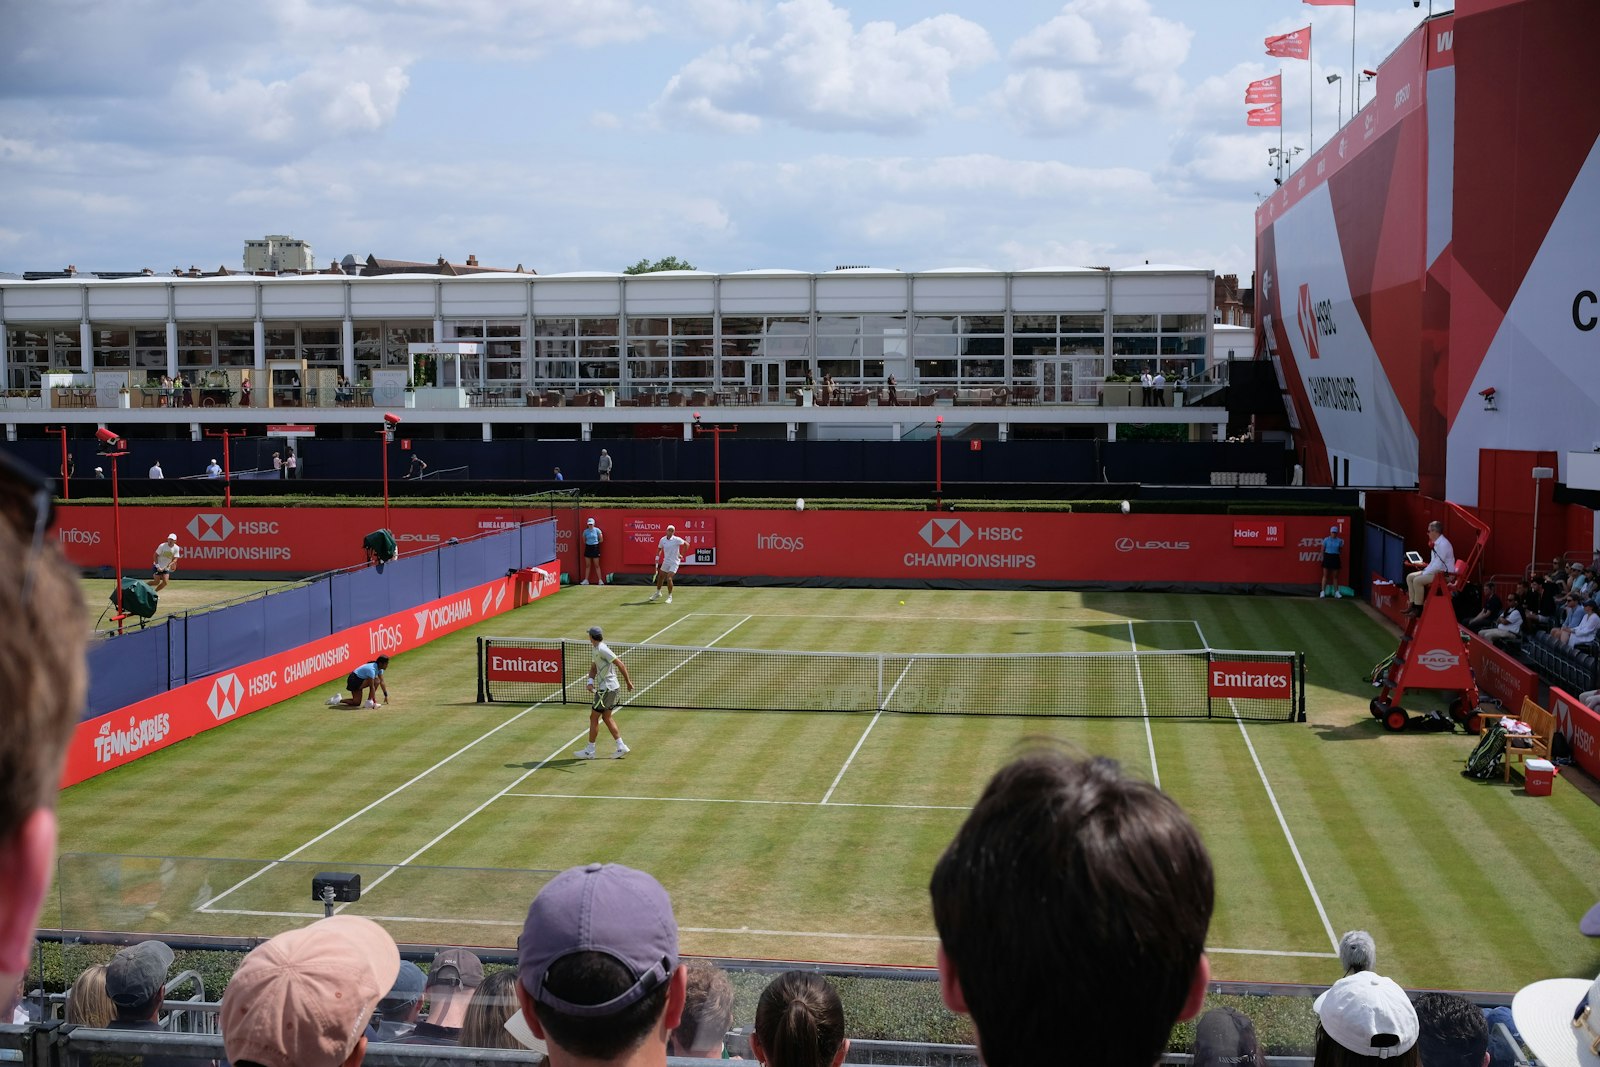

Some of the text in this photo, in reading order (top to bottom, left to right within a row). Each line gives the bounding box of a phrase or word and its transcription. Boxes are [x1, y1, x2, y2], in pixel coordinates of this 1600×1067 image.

[1314, 298, 1337, 336] HSBC
[1572, 290, 1598, 331] C
[1308, 376, 1362, 413] CHAMPIONSHIPS
[238, 521, 279, 535] HSBC
[701, 521, 705, 529] 2
[977, 527, 1024, 541] HSBC
[1234, 529, 1259, 538] Haier
[59, 528, 100, 546] Infosys
[757, 533, 804, 552] Infosys
[1135, 541, 1190, 550] LEXUS
[903, 553, 1036, 568] CHAMPIONSHIPS
[429, 597, 472, 630] YOKOHAMA
[369, 622, 403, 655] Infosys
[249, 643, 350, 697] HSBC CHAMPIONSHIPS
[492, 656, 559, 673] Emirates
[1213, 671, 1287, 688] Emirates
[1573, 725, 1595, 756] HSBC
